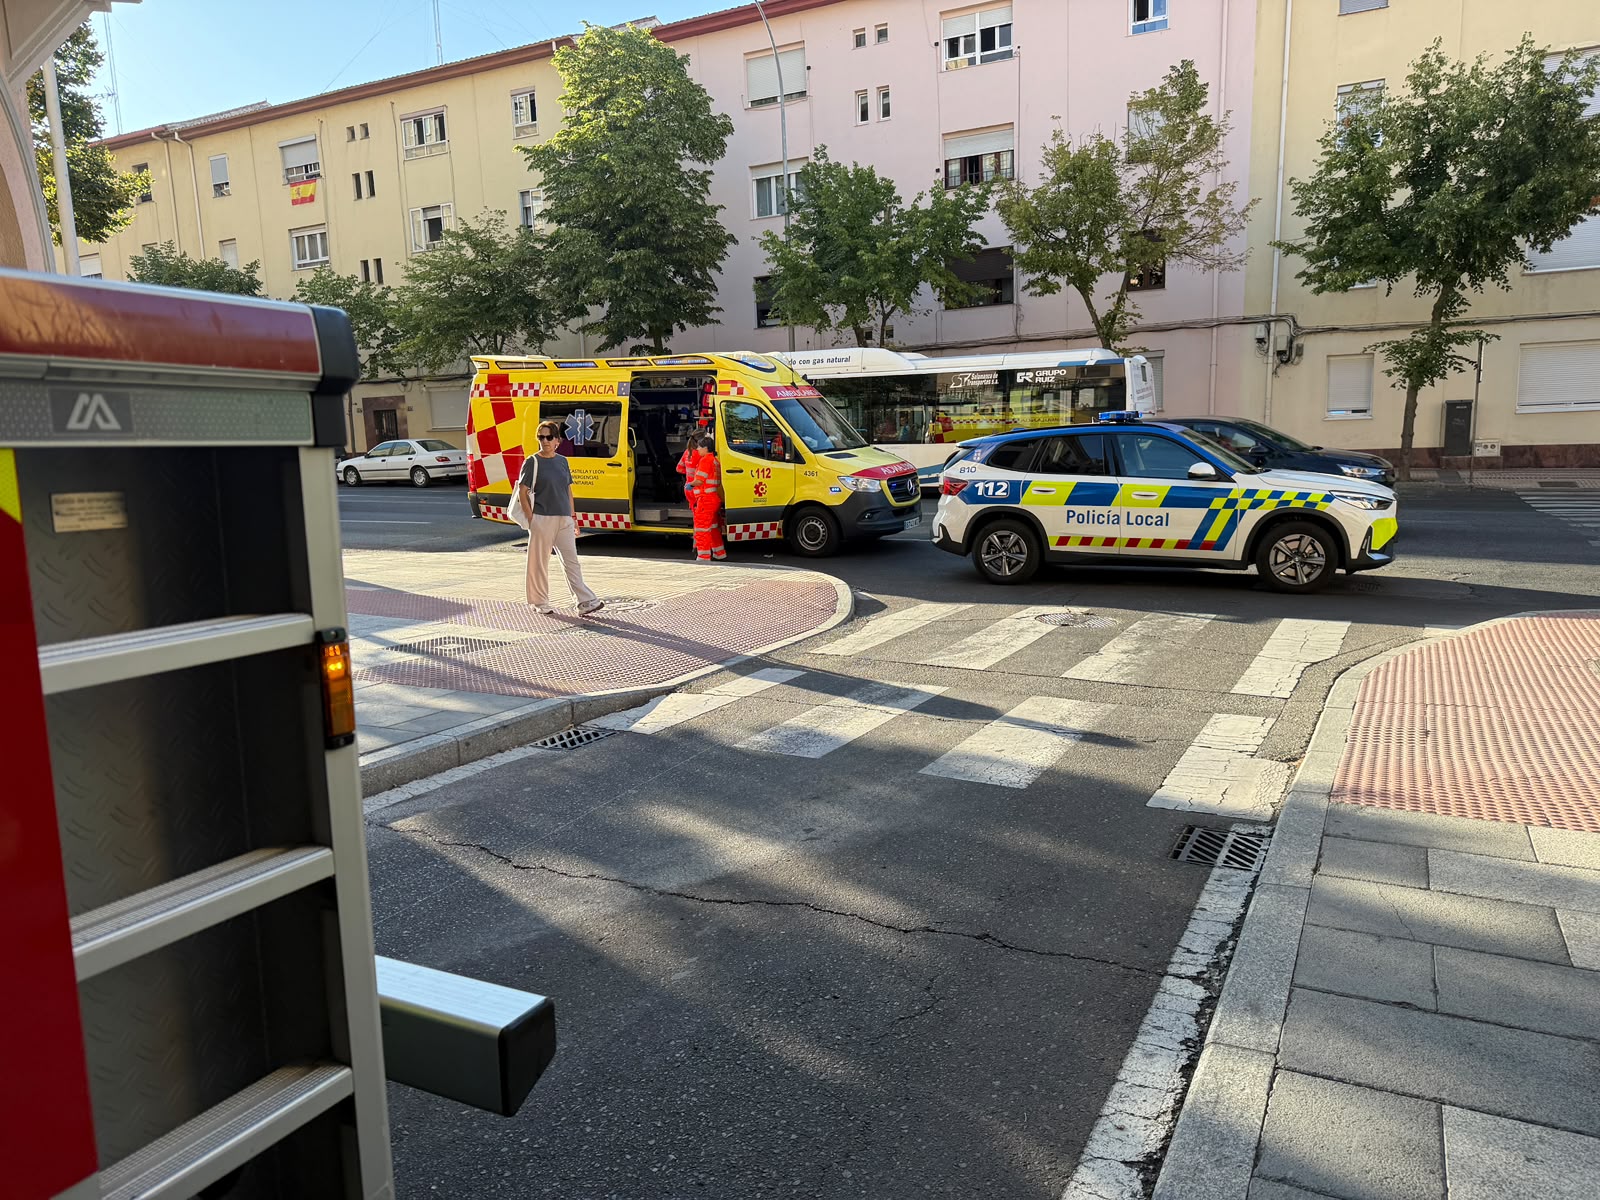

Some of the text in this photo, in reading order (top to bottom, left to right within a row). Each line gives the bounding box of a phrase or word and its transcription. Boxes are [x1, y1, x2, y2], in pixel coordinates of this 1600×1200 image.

[1035, 369, 1067, 377] GRUPO
[542, 384, 615, 395] AMBULANCIA
[755, 467, 772, 479] 112
[974, 481, 1008, 496] 112
[1066, 509, 1169, 527] Policía Local
